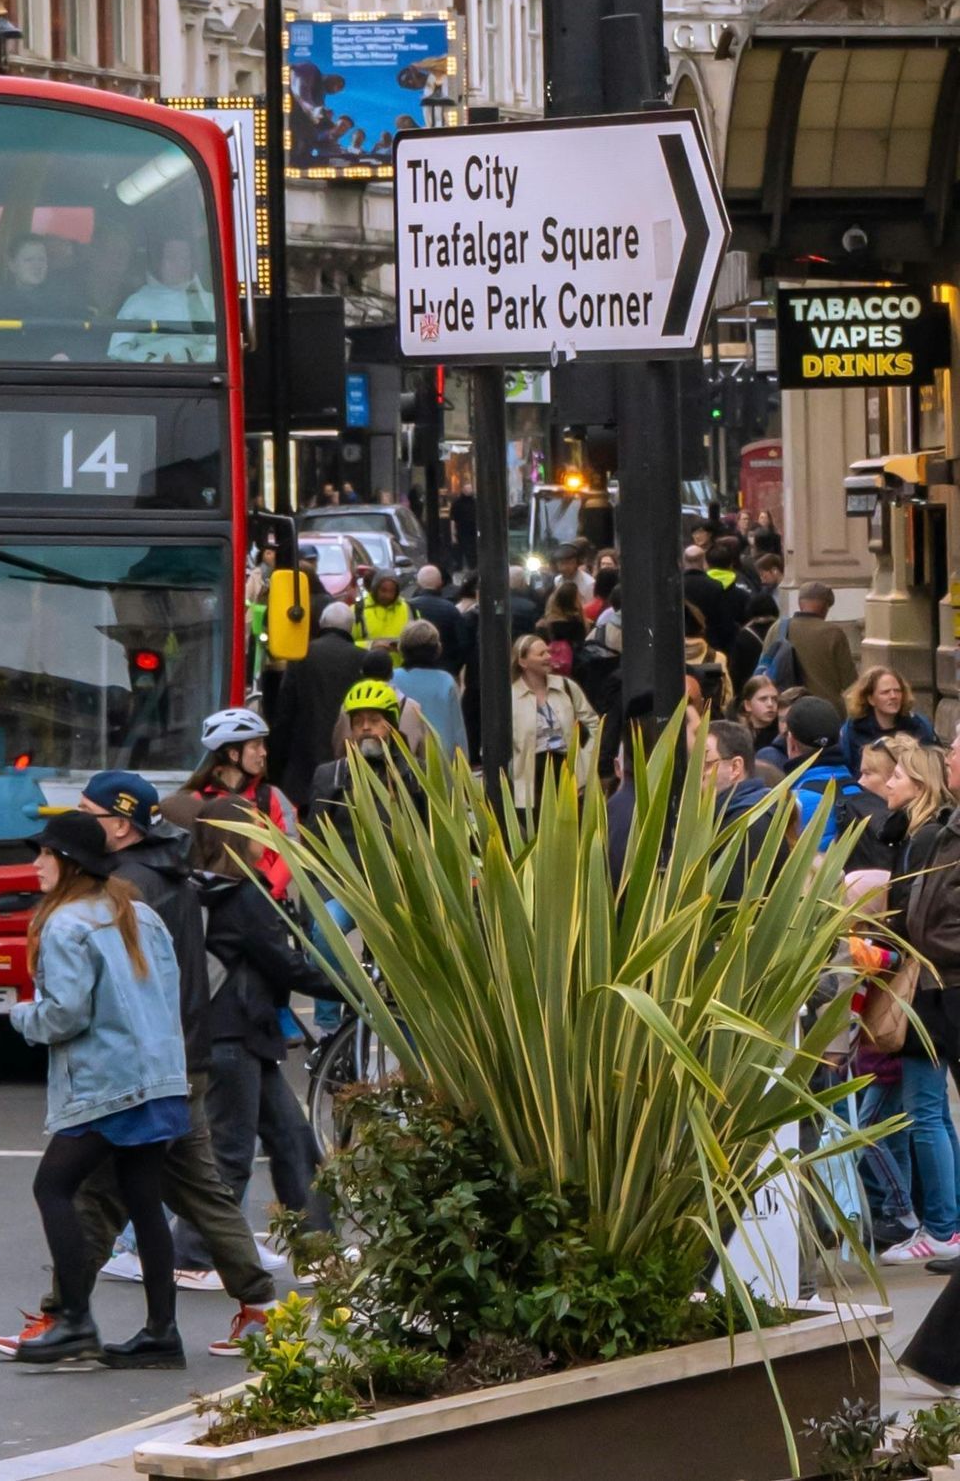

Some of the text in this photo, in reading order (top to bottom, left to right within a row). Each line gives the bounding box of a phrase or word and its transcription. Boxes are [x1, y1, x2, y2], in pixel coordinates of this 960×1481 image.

[407, 154, 518, 208] The City
[408, 217, 639, 275] Trafalgar Square
[409, 282, 653, 333] Hyde Park Corner
[789, 296, 921, 322] TABACCO
[811, 325, 902, 349] VAPES
[802, 353, 913, 378] DRINKS
[62, 429, 128, 488] 14
